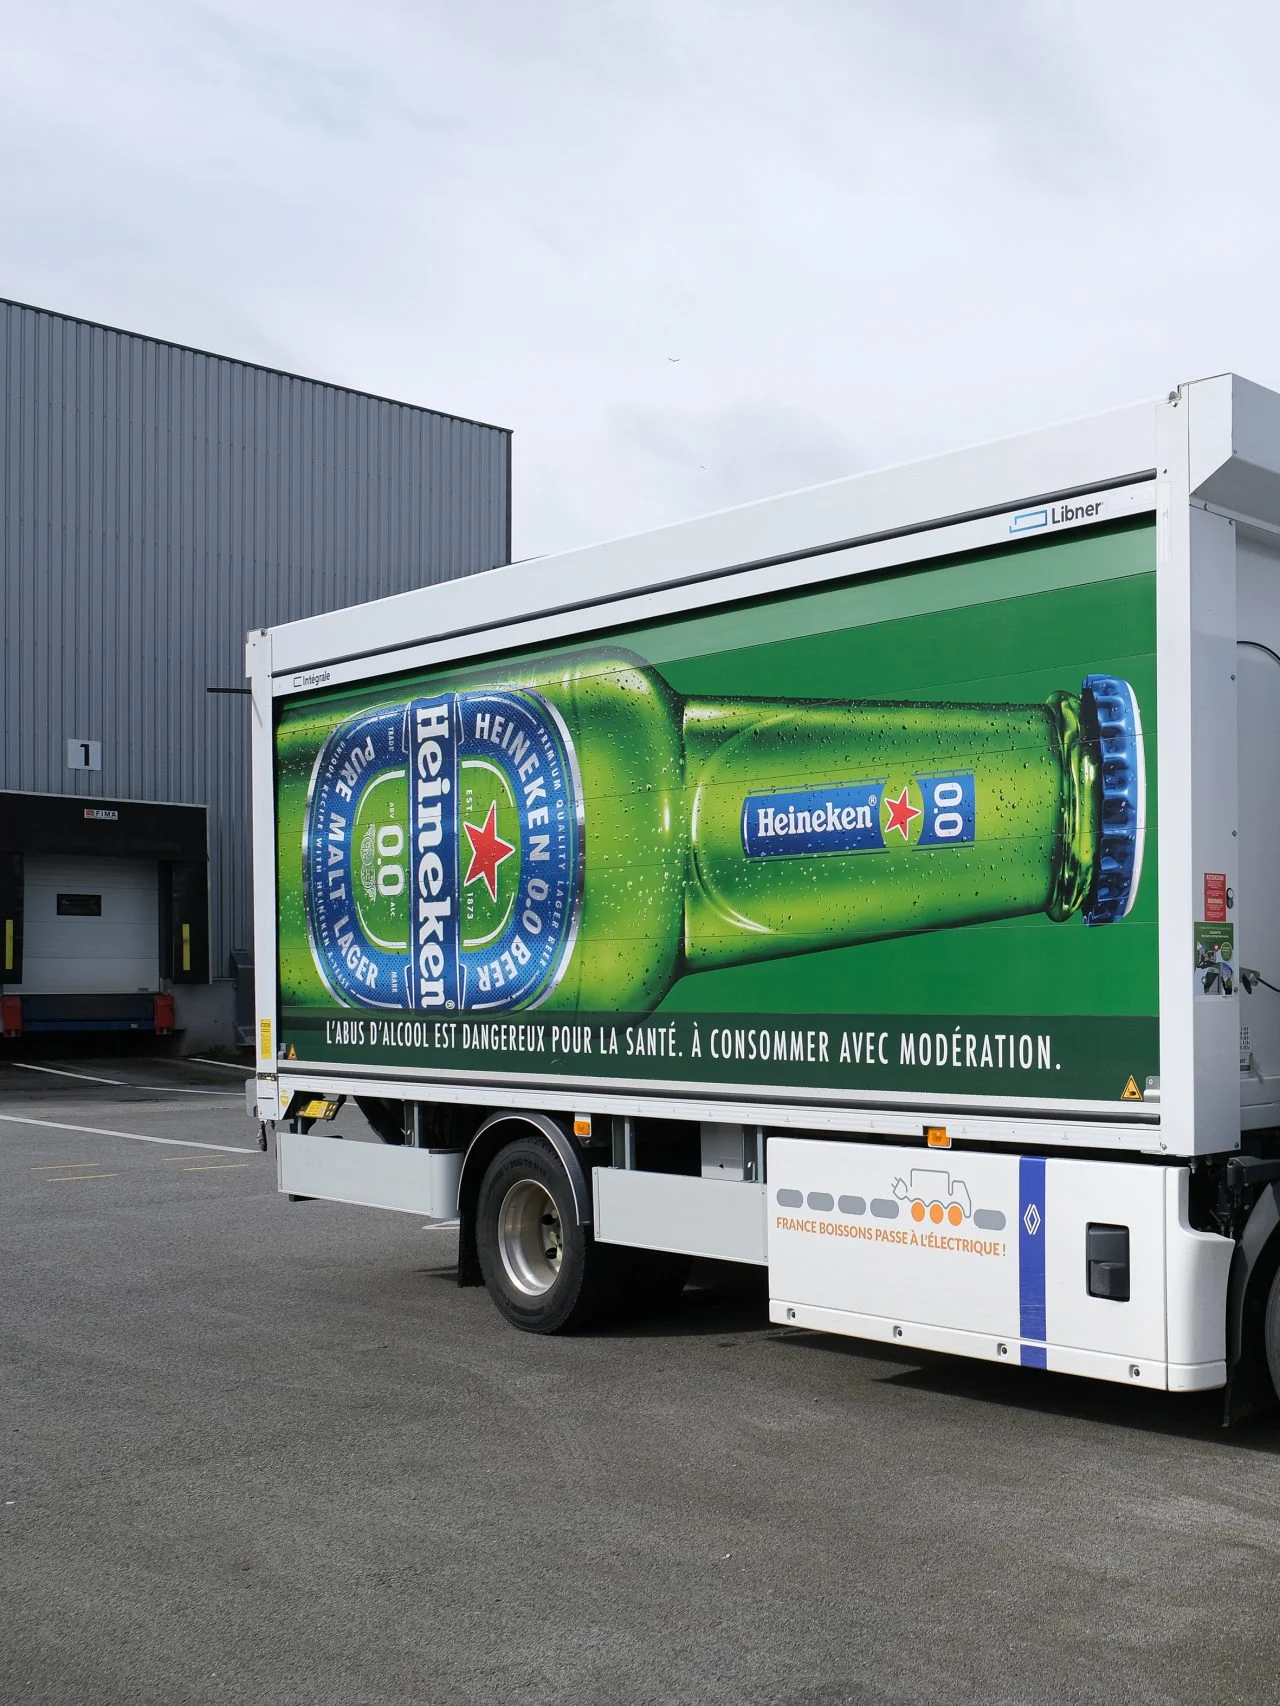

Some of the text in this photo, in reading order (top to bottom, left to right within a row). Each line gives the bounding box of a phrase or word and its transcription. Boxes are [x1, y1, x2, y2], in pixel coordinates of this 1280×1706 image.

[1051, 500, 1102, 525] Libner
[302, 670, 331, 686] Intégrale
[80, 743, 90, 767] 1
[324, 741, 347, 779] UNIQUE
[316, 784, 329, 830] RECIPE
[465, 789, 473, 816] EST.
[315, 837, 323, 874] WITH
[327, 736, 379, 990] PURE MALT LAGER
[376, 823, 405, 897] 0.0
[475, 713, 550, 992] HEINEKEN 0.0 BEER
[538, 728, 565, 968] PREMIUM QUALITY LAGER BEER
[315, 881, 331, 947] HEINEKEN
[466, 892, 474, 920] 1873
[326, 1020, 1062, 1071] L'ABUS D'ALCOOL EST DANGEREUX POUR LA SANTÉ. À CONSOMMER AVEC MODÉRATION.
[776, 1216, 817, 1235] FRANCE
[819, 1221, 874, 1241] BOISSONS
[875, 1227, 909, 1246] PASSE
[910, 1228, 919, 1247] À
[920, 1232, 1000, 1256] L'ÉLECTRIQUE
